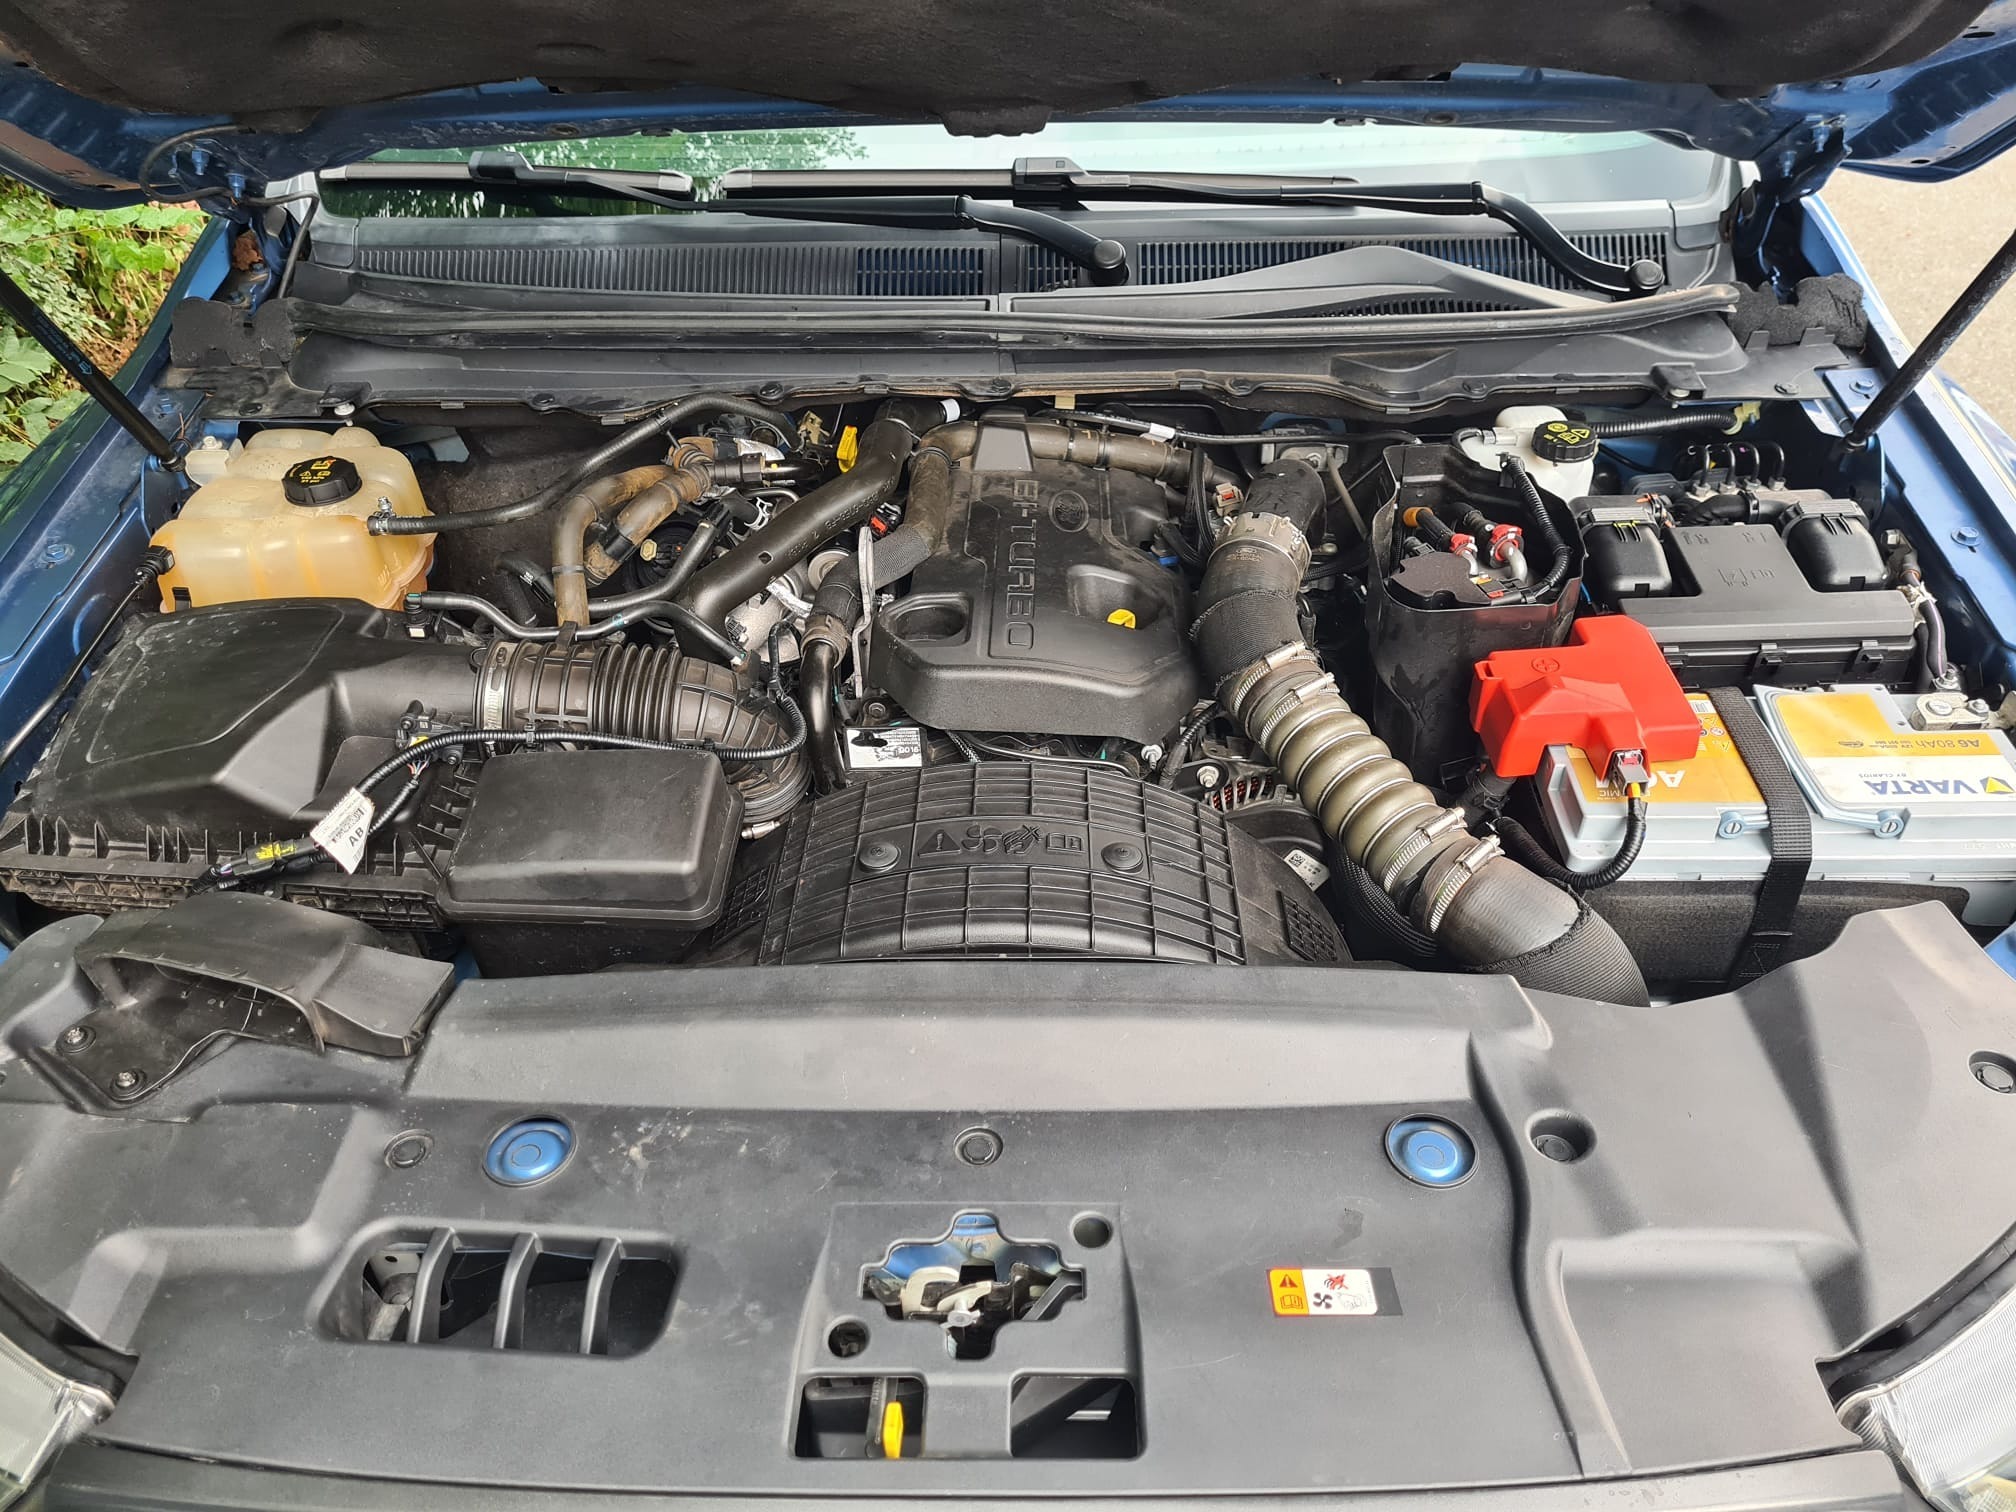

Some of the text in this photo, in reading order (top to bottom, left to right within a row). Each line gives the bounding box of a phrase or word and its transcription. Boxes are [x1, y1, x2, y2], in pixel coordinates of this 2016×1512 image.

[1006, 479, 1038, 650] BI-TURBO
[1915, 738, 1956, 749] 80Ah
[1958, 738, 1980, 748] A6
[1863, 779, 1978, 795] VARTA
[348, 827, 364, 847] AB
